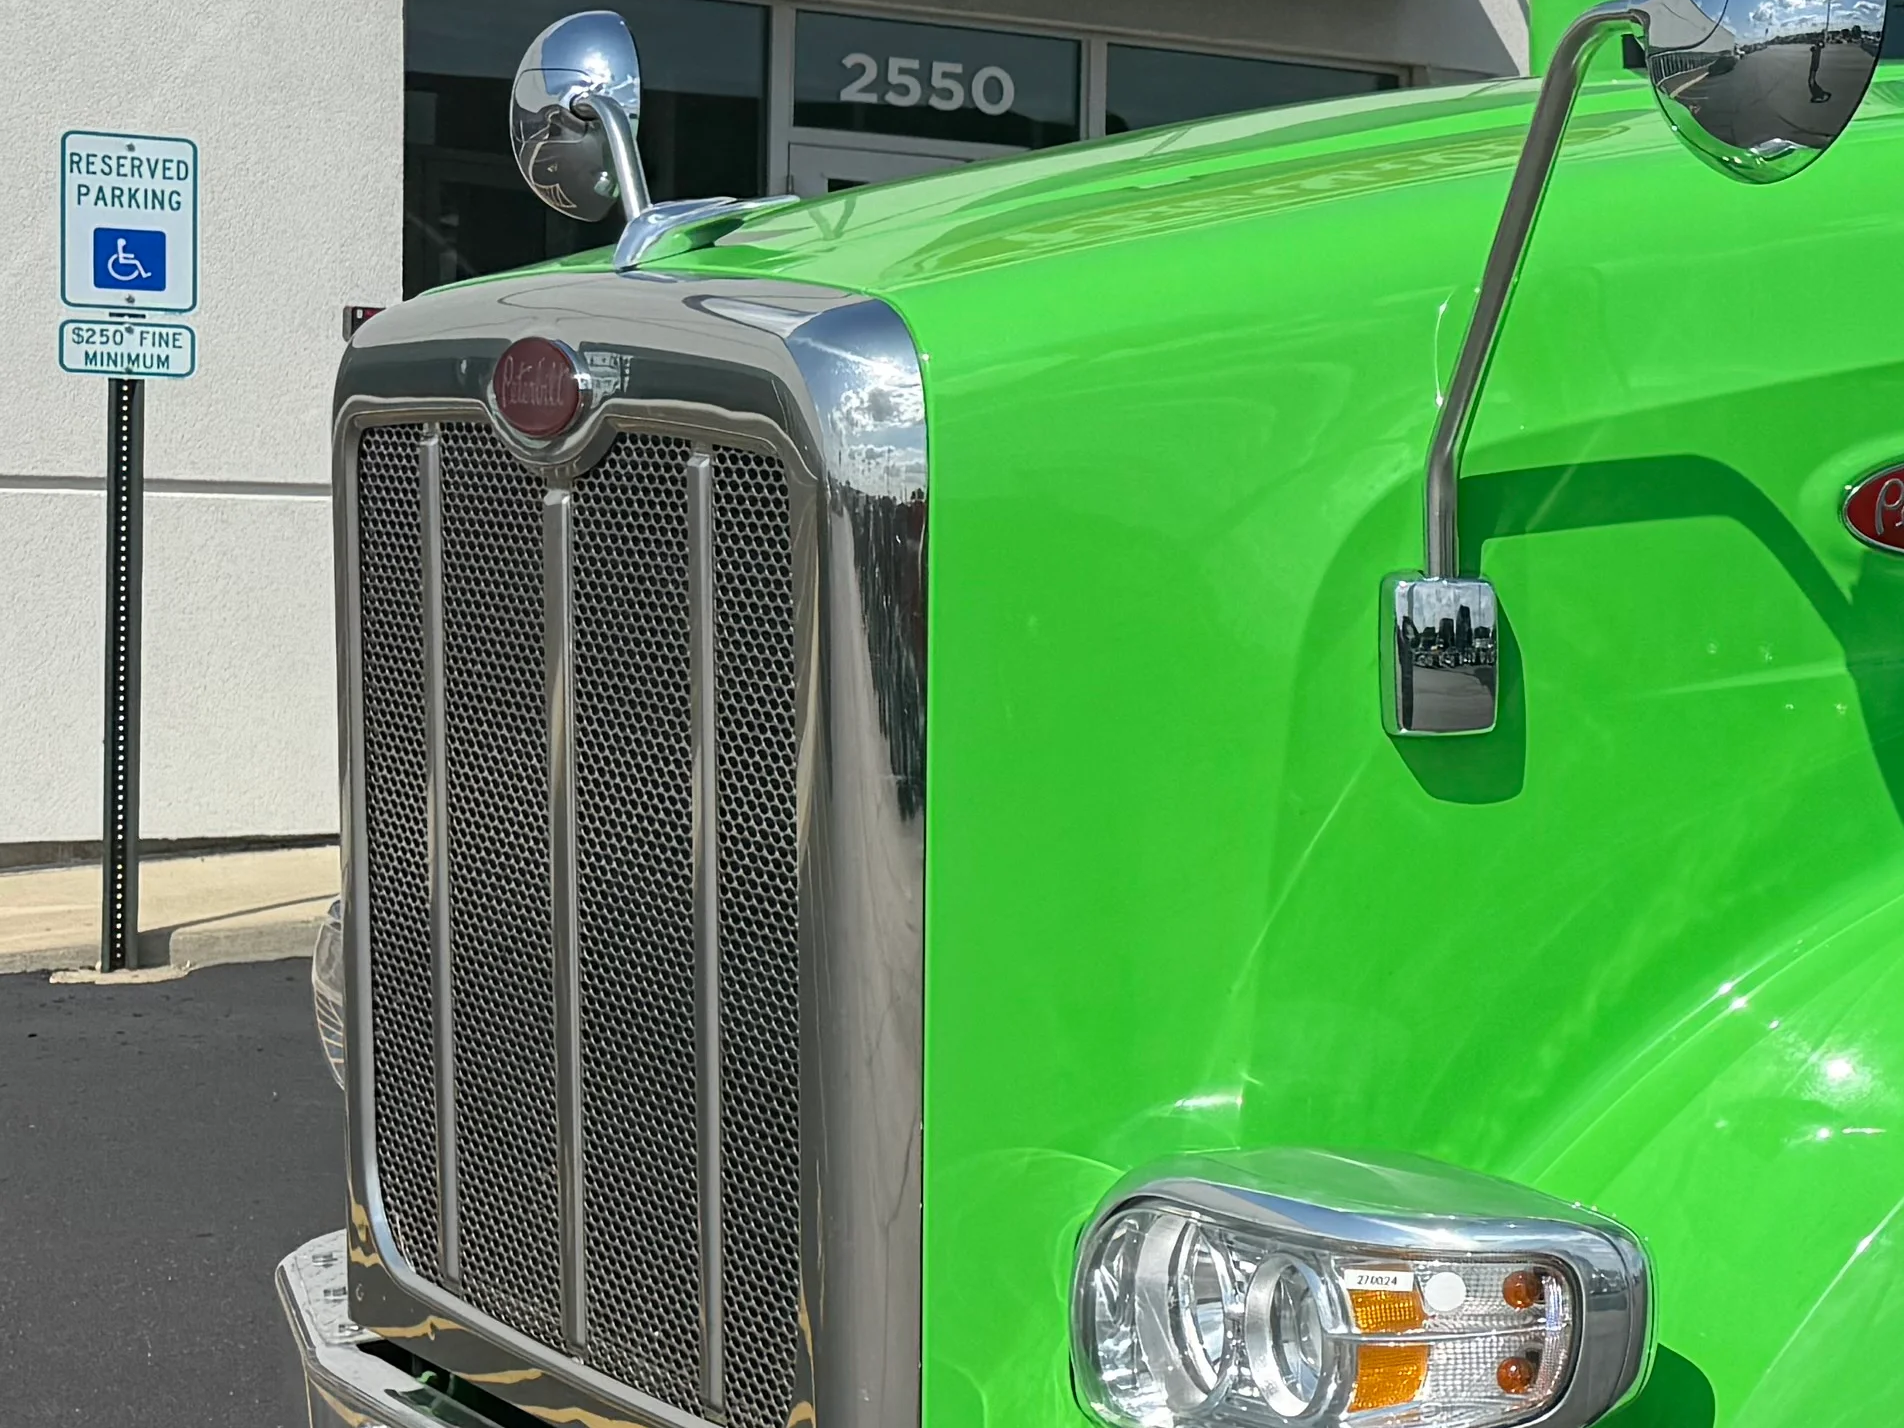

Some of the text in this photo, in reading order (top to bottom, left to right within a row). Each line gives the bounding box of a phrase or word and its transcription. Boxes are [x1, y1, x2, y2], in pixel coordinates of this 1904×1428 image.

[839, 52, 1015, 116] 2550
[69, 152, 189, 181] RESERVED
[77, 184, 182, 212] PARKING
[72, 326, 183, 349] $250 FINE
[84, 350, 170, 370] MINIMUM
